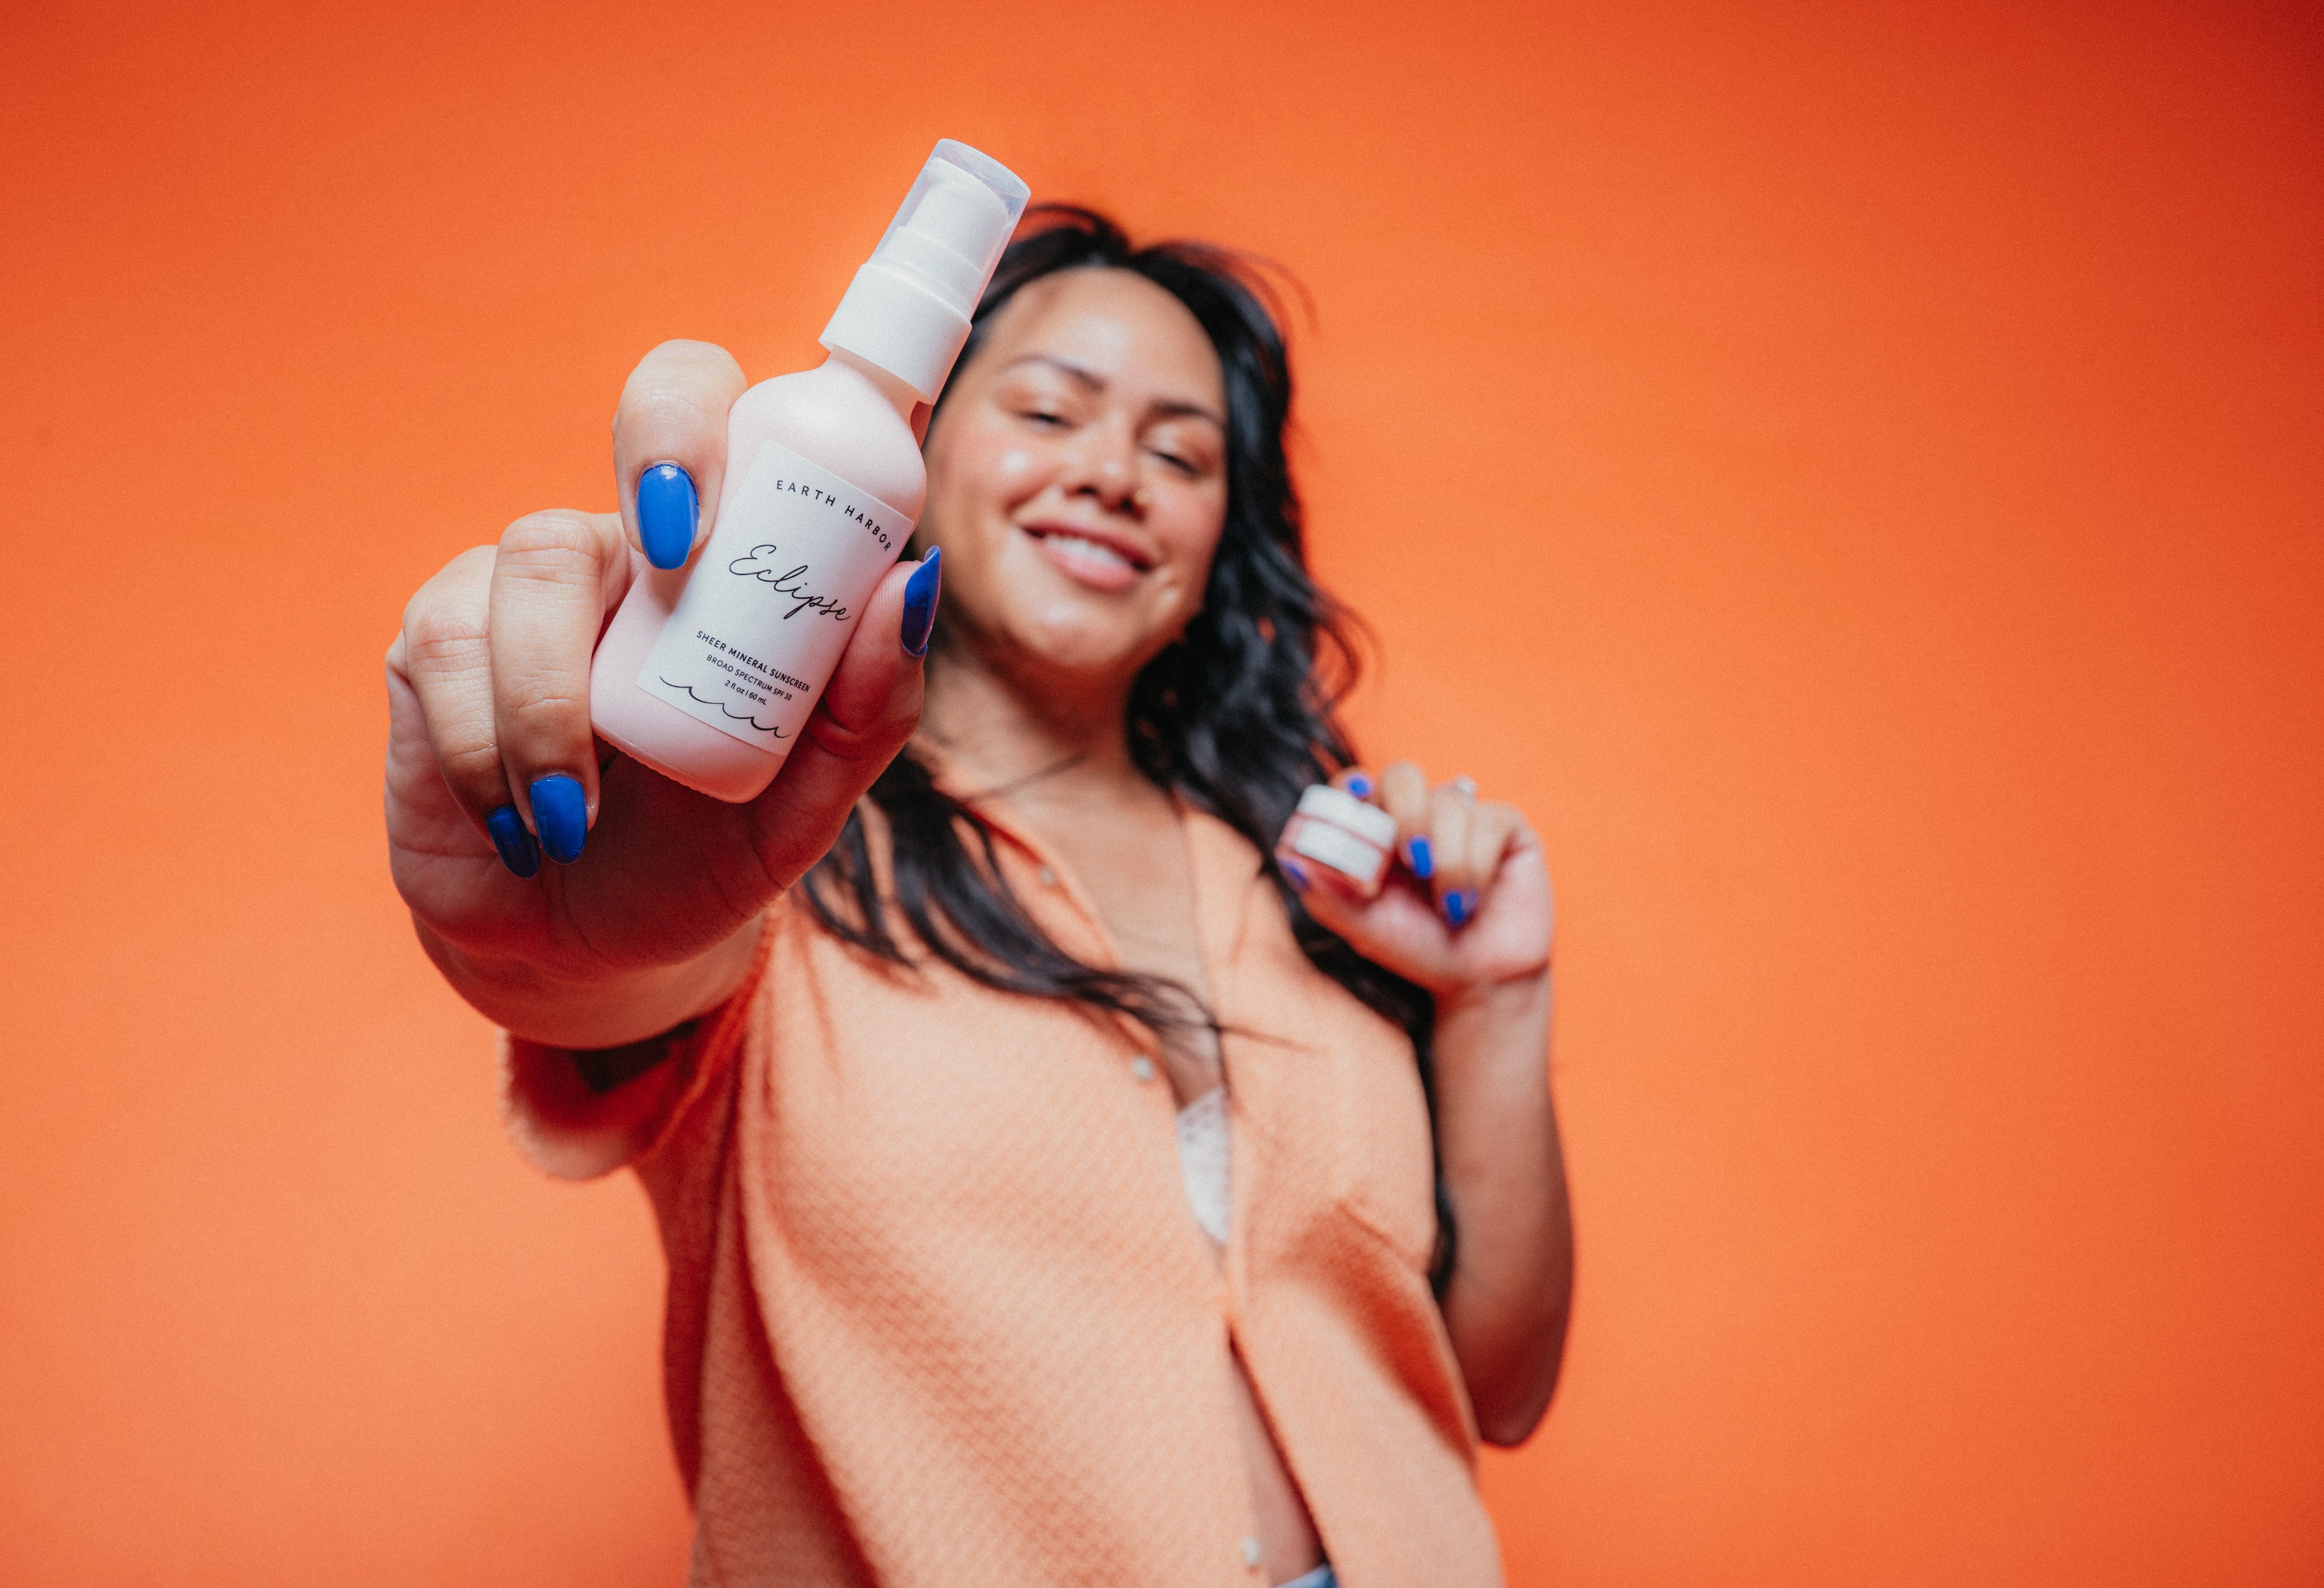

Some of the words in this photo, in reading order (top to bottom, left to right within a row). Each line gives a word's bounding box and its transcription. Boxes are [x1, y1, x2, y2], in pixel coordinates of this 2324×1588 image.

[777, 480, 836, 506] EARTH
[844, 505, 891, 552] HARBOR
[729, 544, 851, 620] Eclipse
[696, 631, 727, 651] SHEER
[728, 648, 767, 673] MINERAL
[769, 669, 811, 692] SUNSCREEN
[706, 654, 734, 672] BROAD
[735, 669, 772, 692] SPECTRUM
[773, 688, 785, 696] SPF
